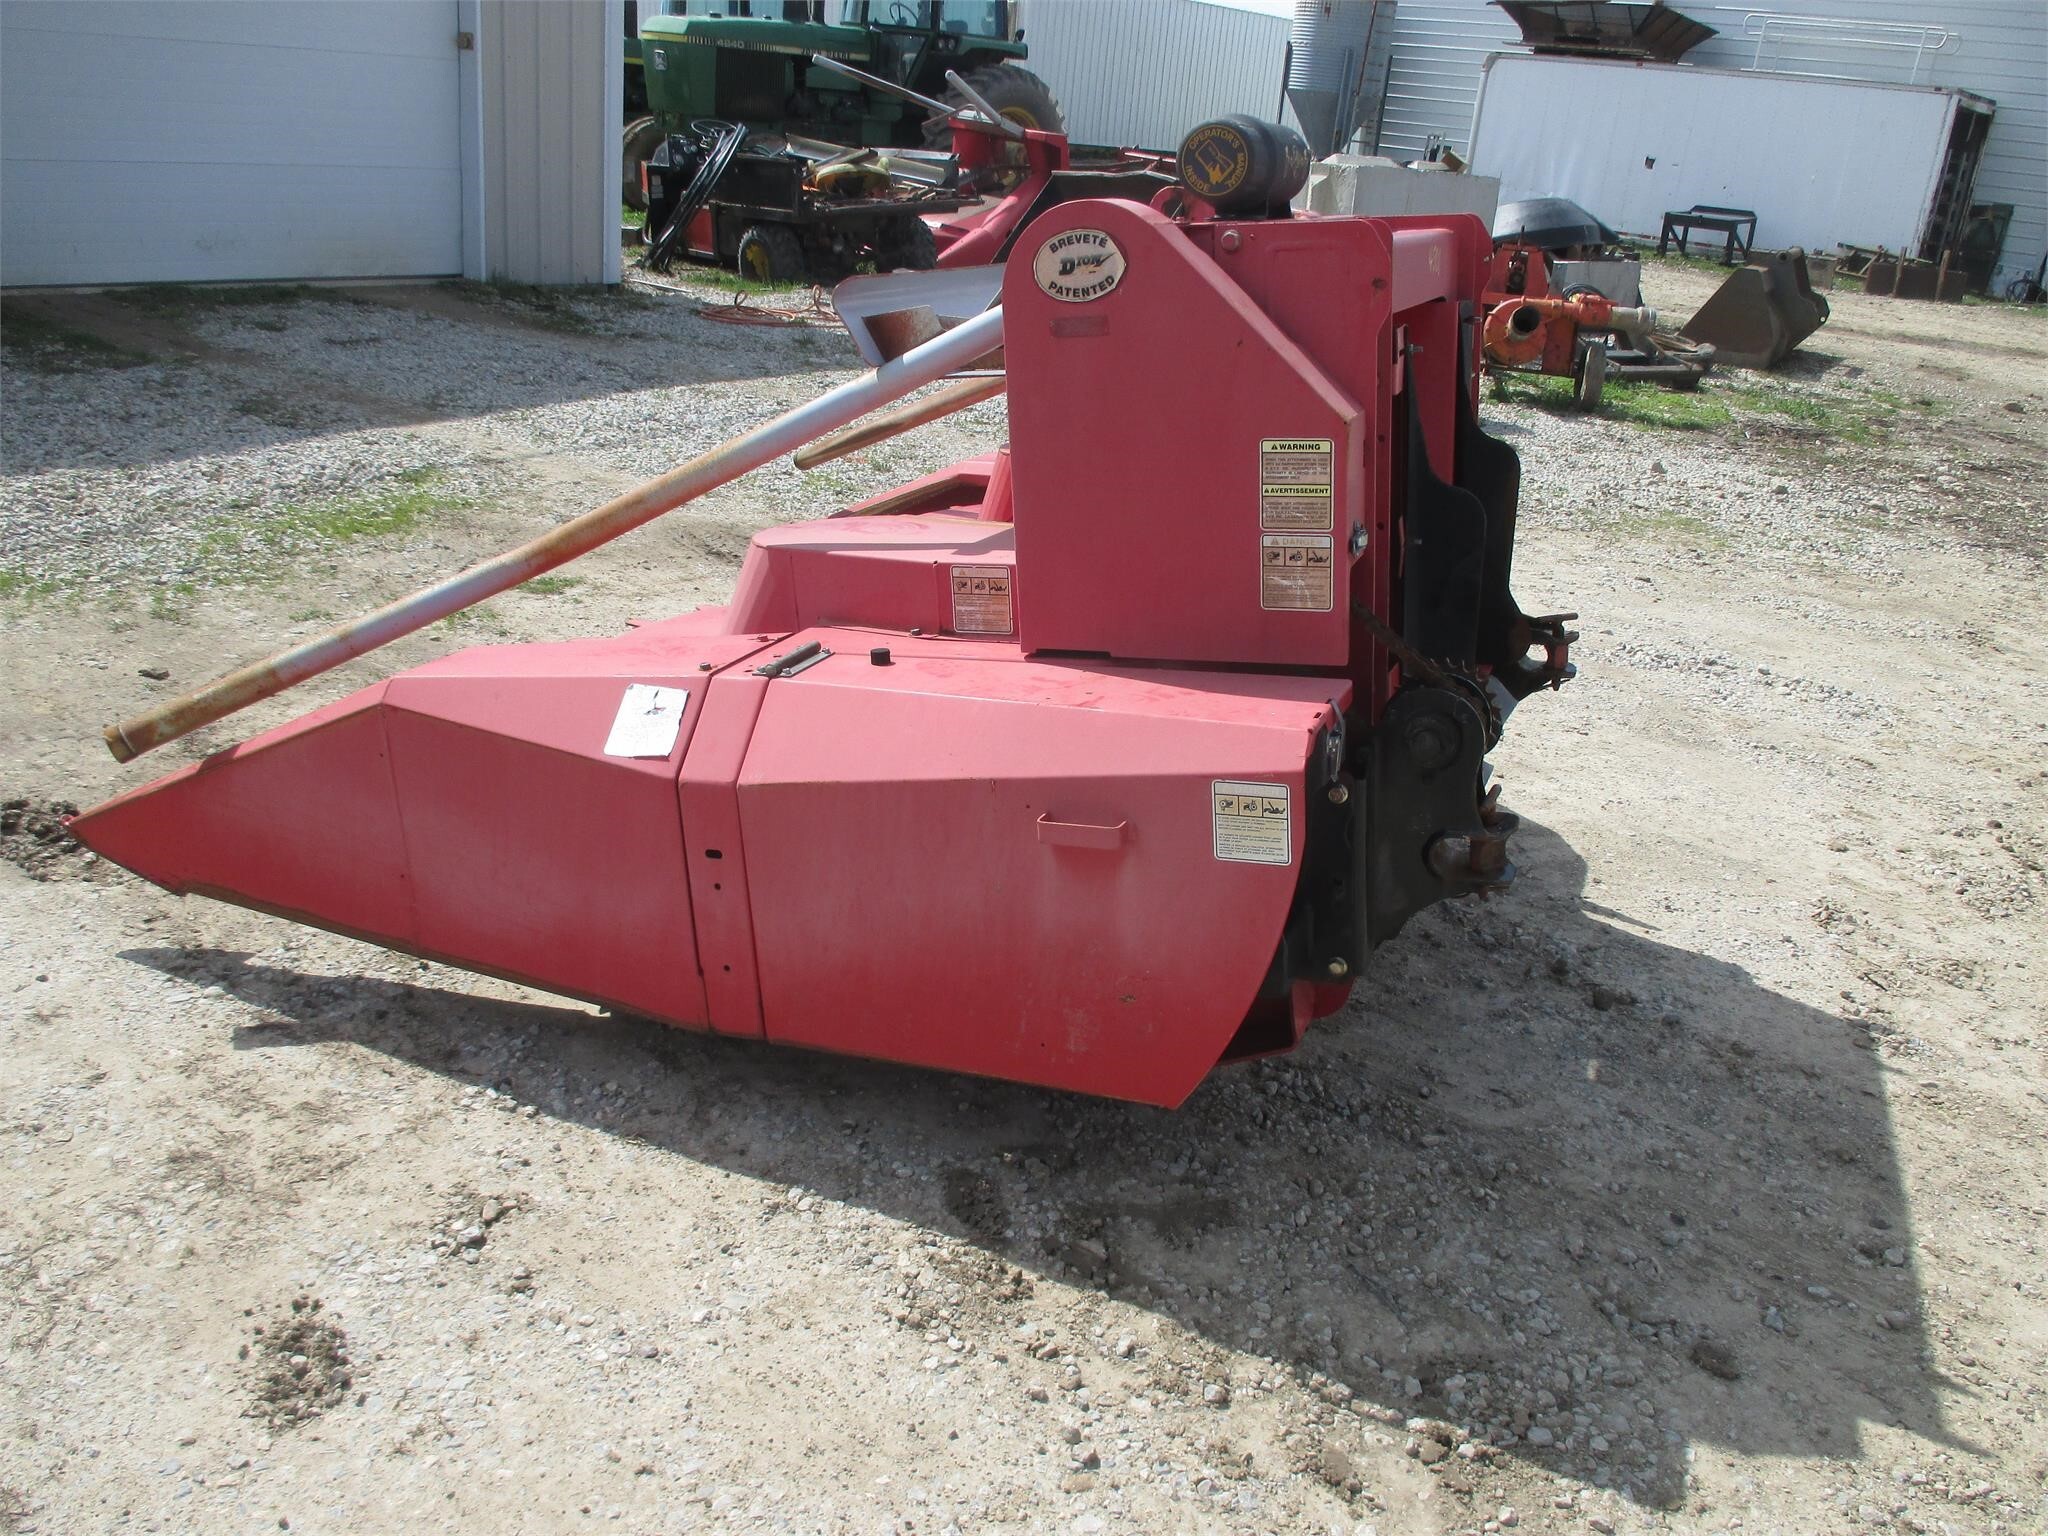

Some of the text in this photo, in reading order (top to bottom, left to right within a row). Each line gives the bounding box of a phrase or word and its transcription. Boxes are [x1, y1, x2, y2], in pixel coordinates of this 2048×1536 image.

[1185, 126, 1246, 192] OPERATOR'S MANUAL INSIDE
[1049, 233, 1108, 253] BREVETÉ
[1049, 275, 1115, 297] PATENTED
[1282, 538, 1322, 546] DANGE
